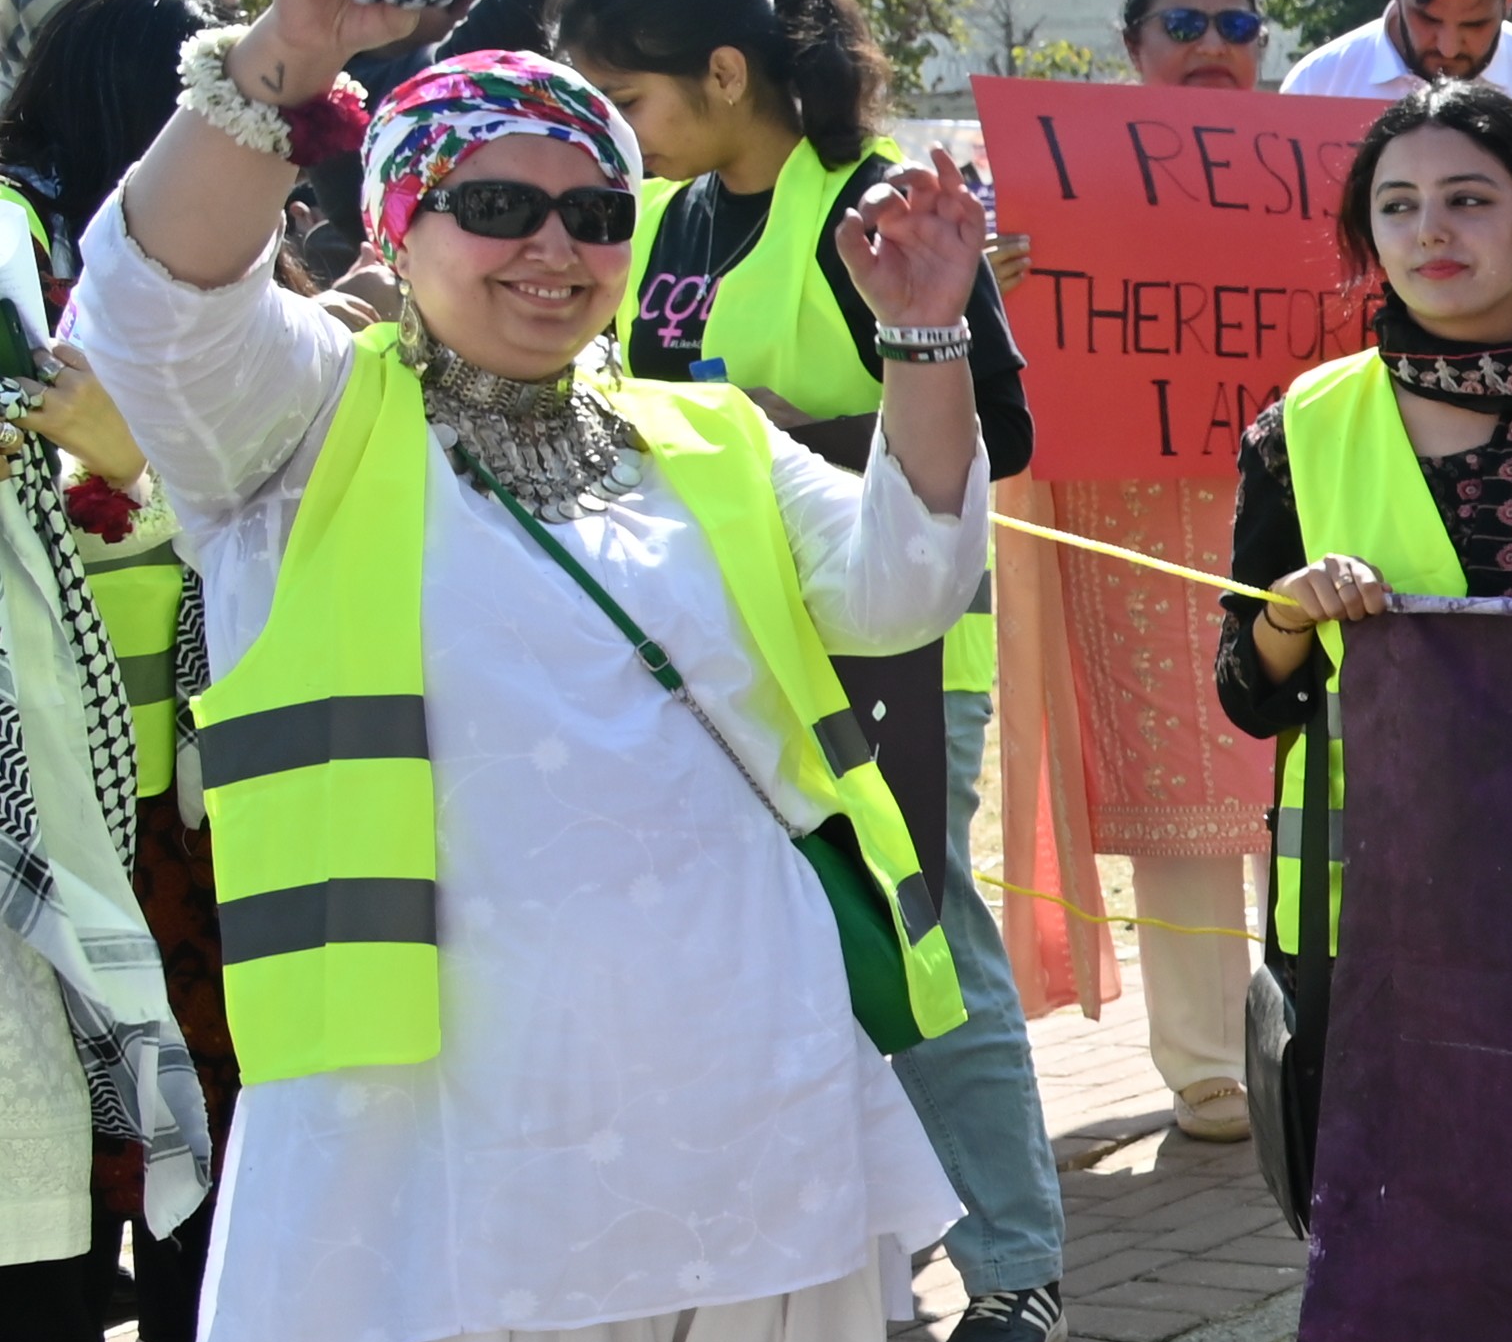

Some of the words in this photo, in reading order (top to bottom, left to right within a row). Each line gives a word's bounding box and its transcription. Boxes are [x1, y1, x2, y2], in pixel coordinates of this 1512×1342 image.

[1037, 116, 1078, 200] I
[1126, 120, 1362, 221] RESIS
[1150, 379, 1178, 455] I
